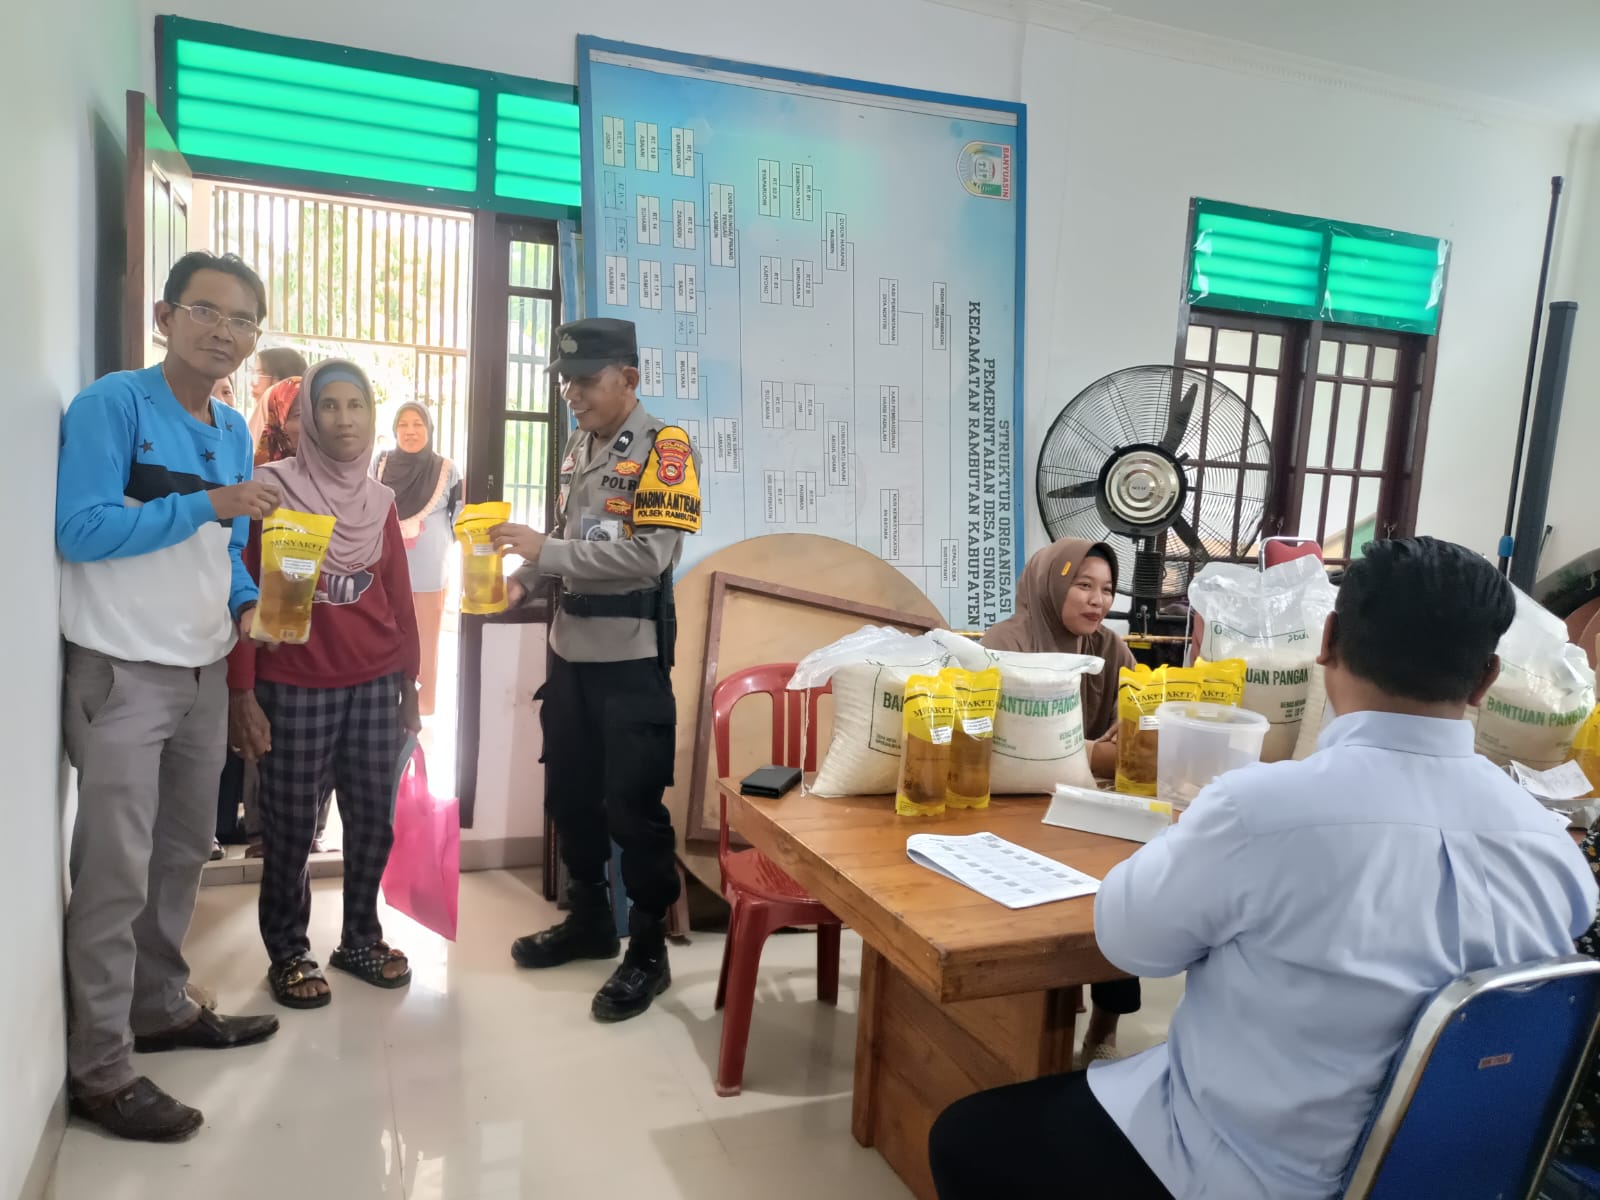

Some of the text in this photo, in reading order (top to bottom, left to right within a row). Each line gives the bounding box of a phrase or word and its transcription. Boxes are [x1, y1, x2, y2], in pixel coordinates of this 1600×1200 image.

[1002, 147, 1010, 198] BANYUASIN
[983, 358, 996, 495] PEMERINTAHAN
[601, 475, 637, 491] POLR
[967, 300, 981, 626] KECAMATAN RAMBUTAN KABUPATEN
[638, 510, 662, 518] POLSEK
[983, 499, 996, 542] DESA
[998, 419, 1012, 614] STRUKTUR ORGANISASI
[983, 546, 996, 608] SUNGAI
[997, 693, 1049, 718] ANTUAN
[1486, 696, 1546, 727] BANTUAN
